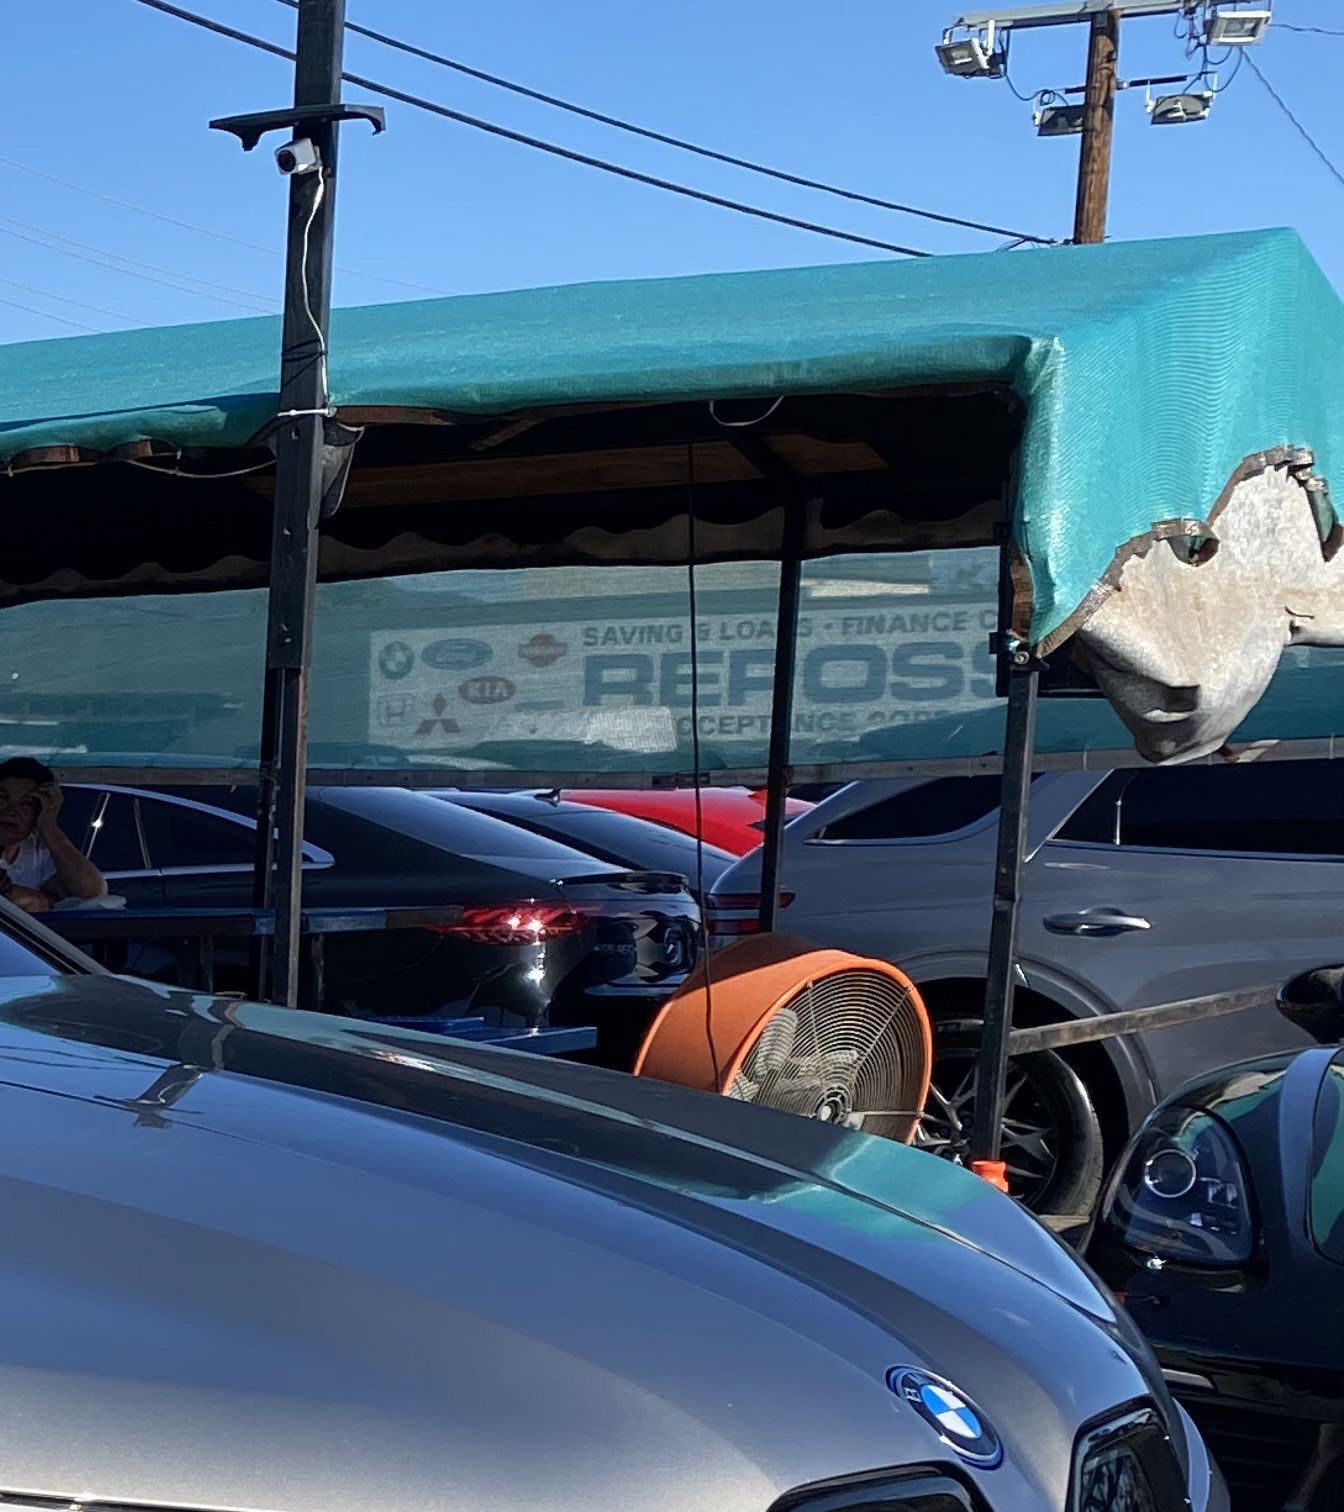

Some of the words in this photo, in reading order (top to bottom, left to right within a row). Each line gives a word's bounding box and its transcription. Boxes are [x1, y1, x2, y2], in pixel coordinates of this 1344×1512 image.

[582, 624, 684, 647] SAVING
[720, 617, 813, 642] LOAS
[841, 610, 968, 636] FINANCE
